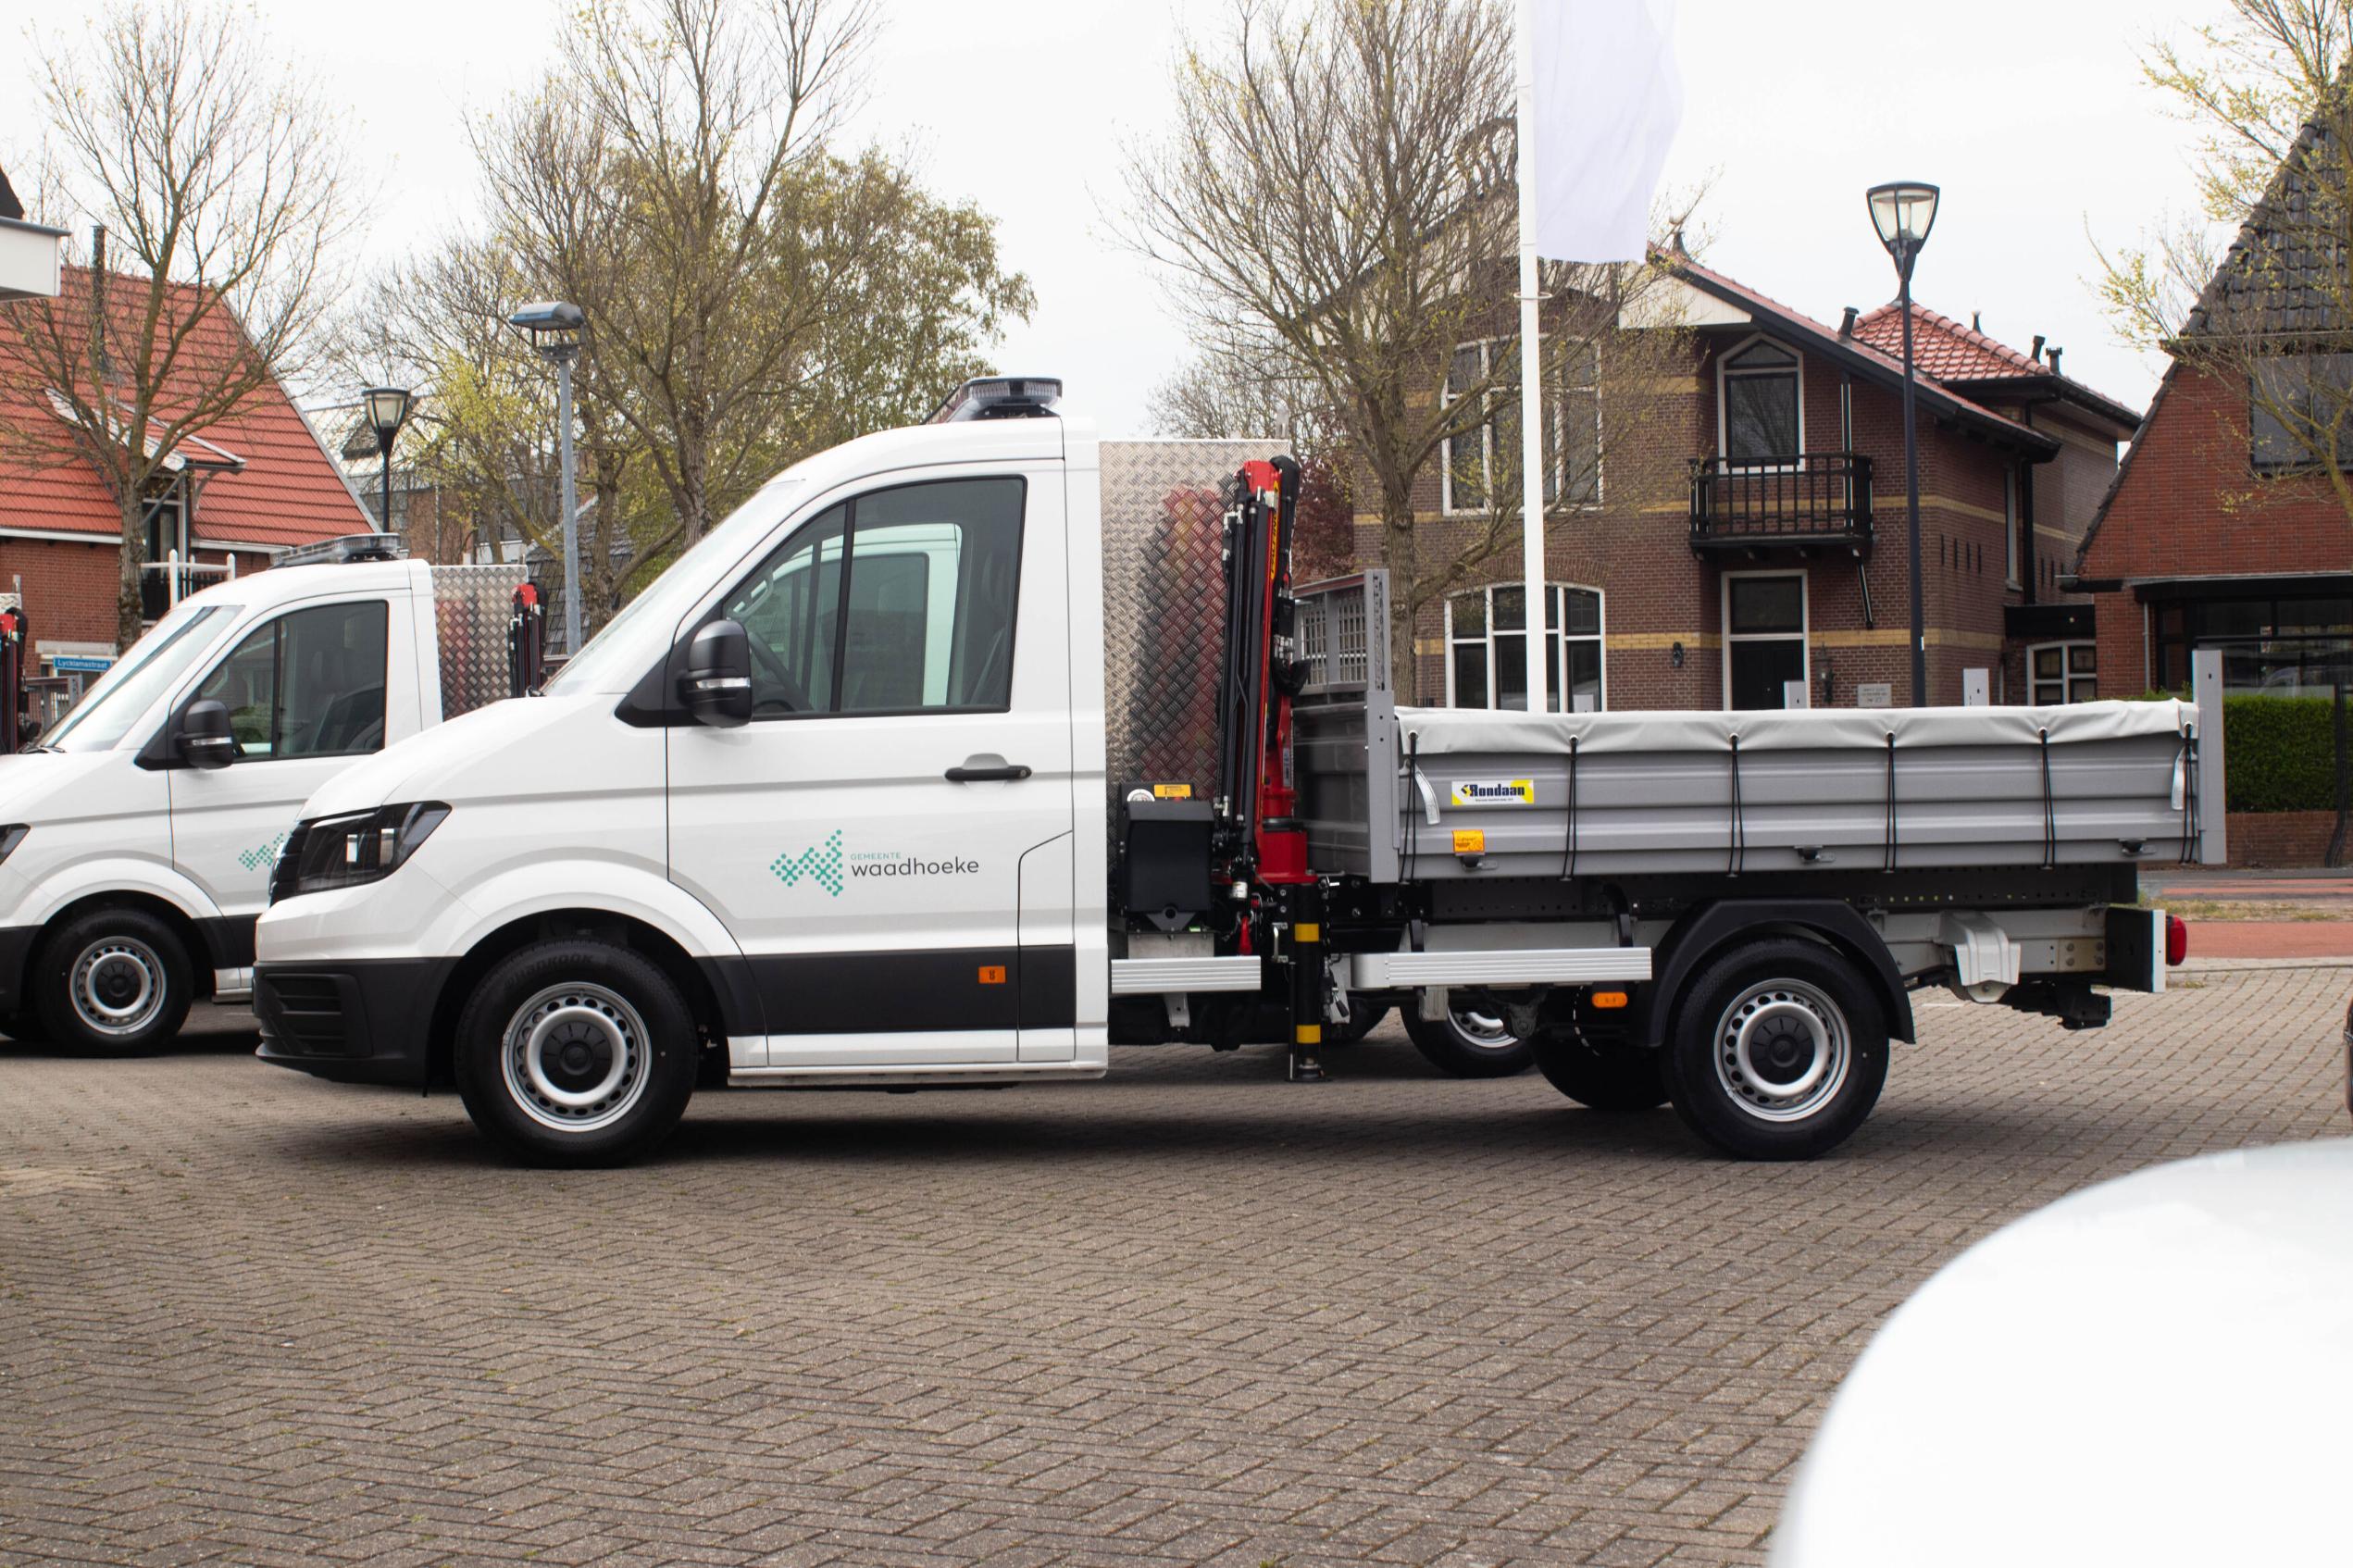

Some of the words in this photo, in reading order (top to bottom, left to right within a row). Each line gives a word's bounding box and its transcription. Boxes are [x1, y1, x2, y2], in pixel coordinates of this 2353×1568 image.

[57, 658, 107, 668] Lycklamastraat
[1469, 783, 1525, 796] Rondaan
[850, 852, 902, 861] GEMEENTE
[851, 855, 979, 877] waadhoeke
